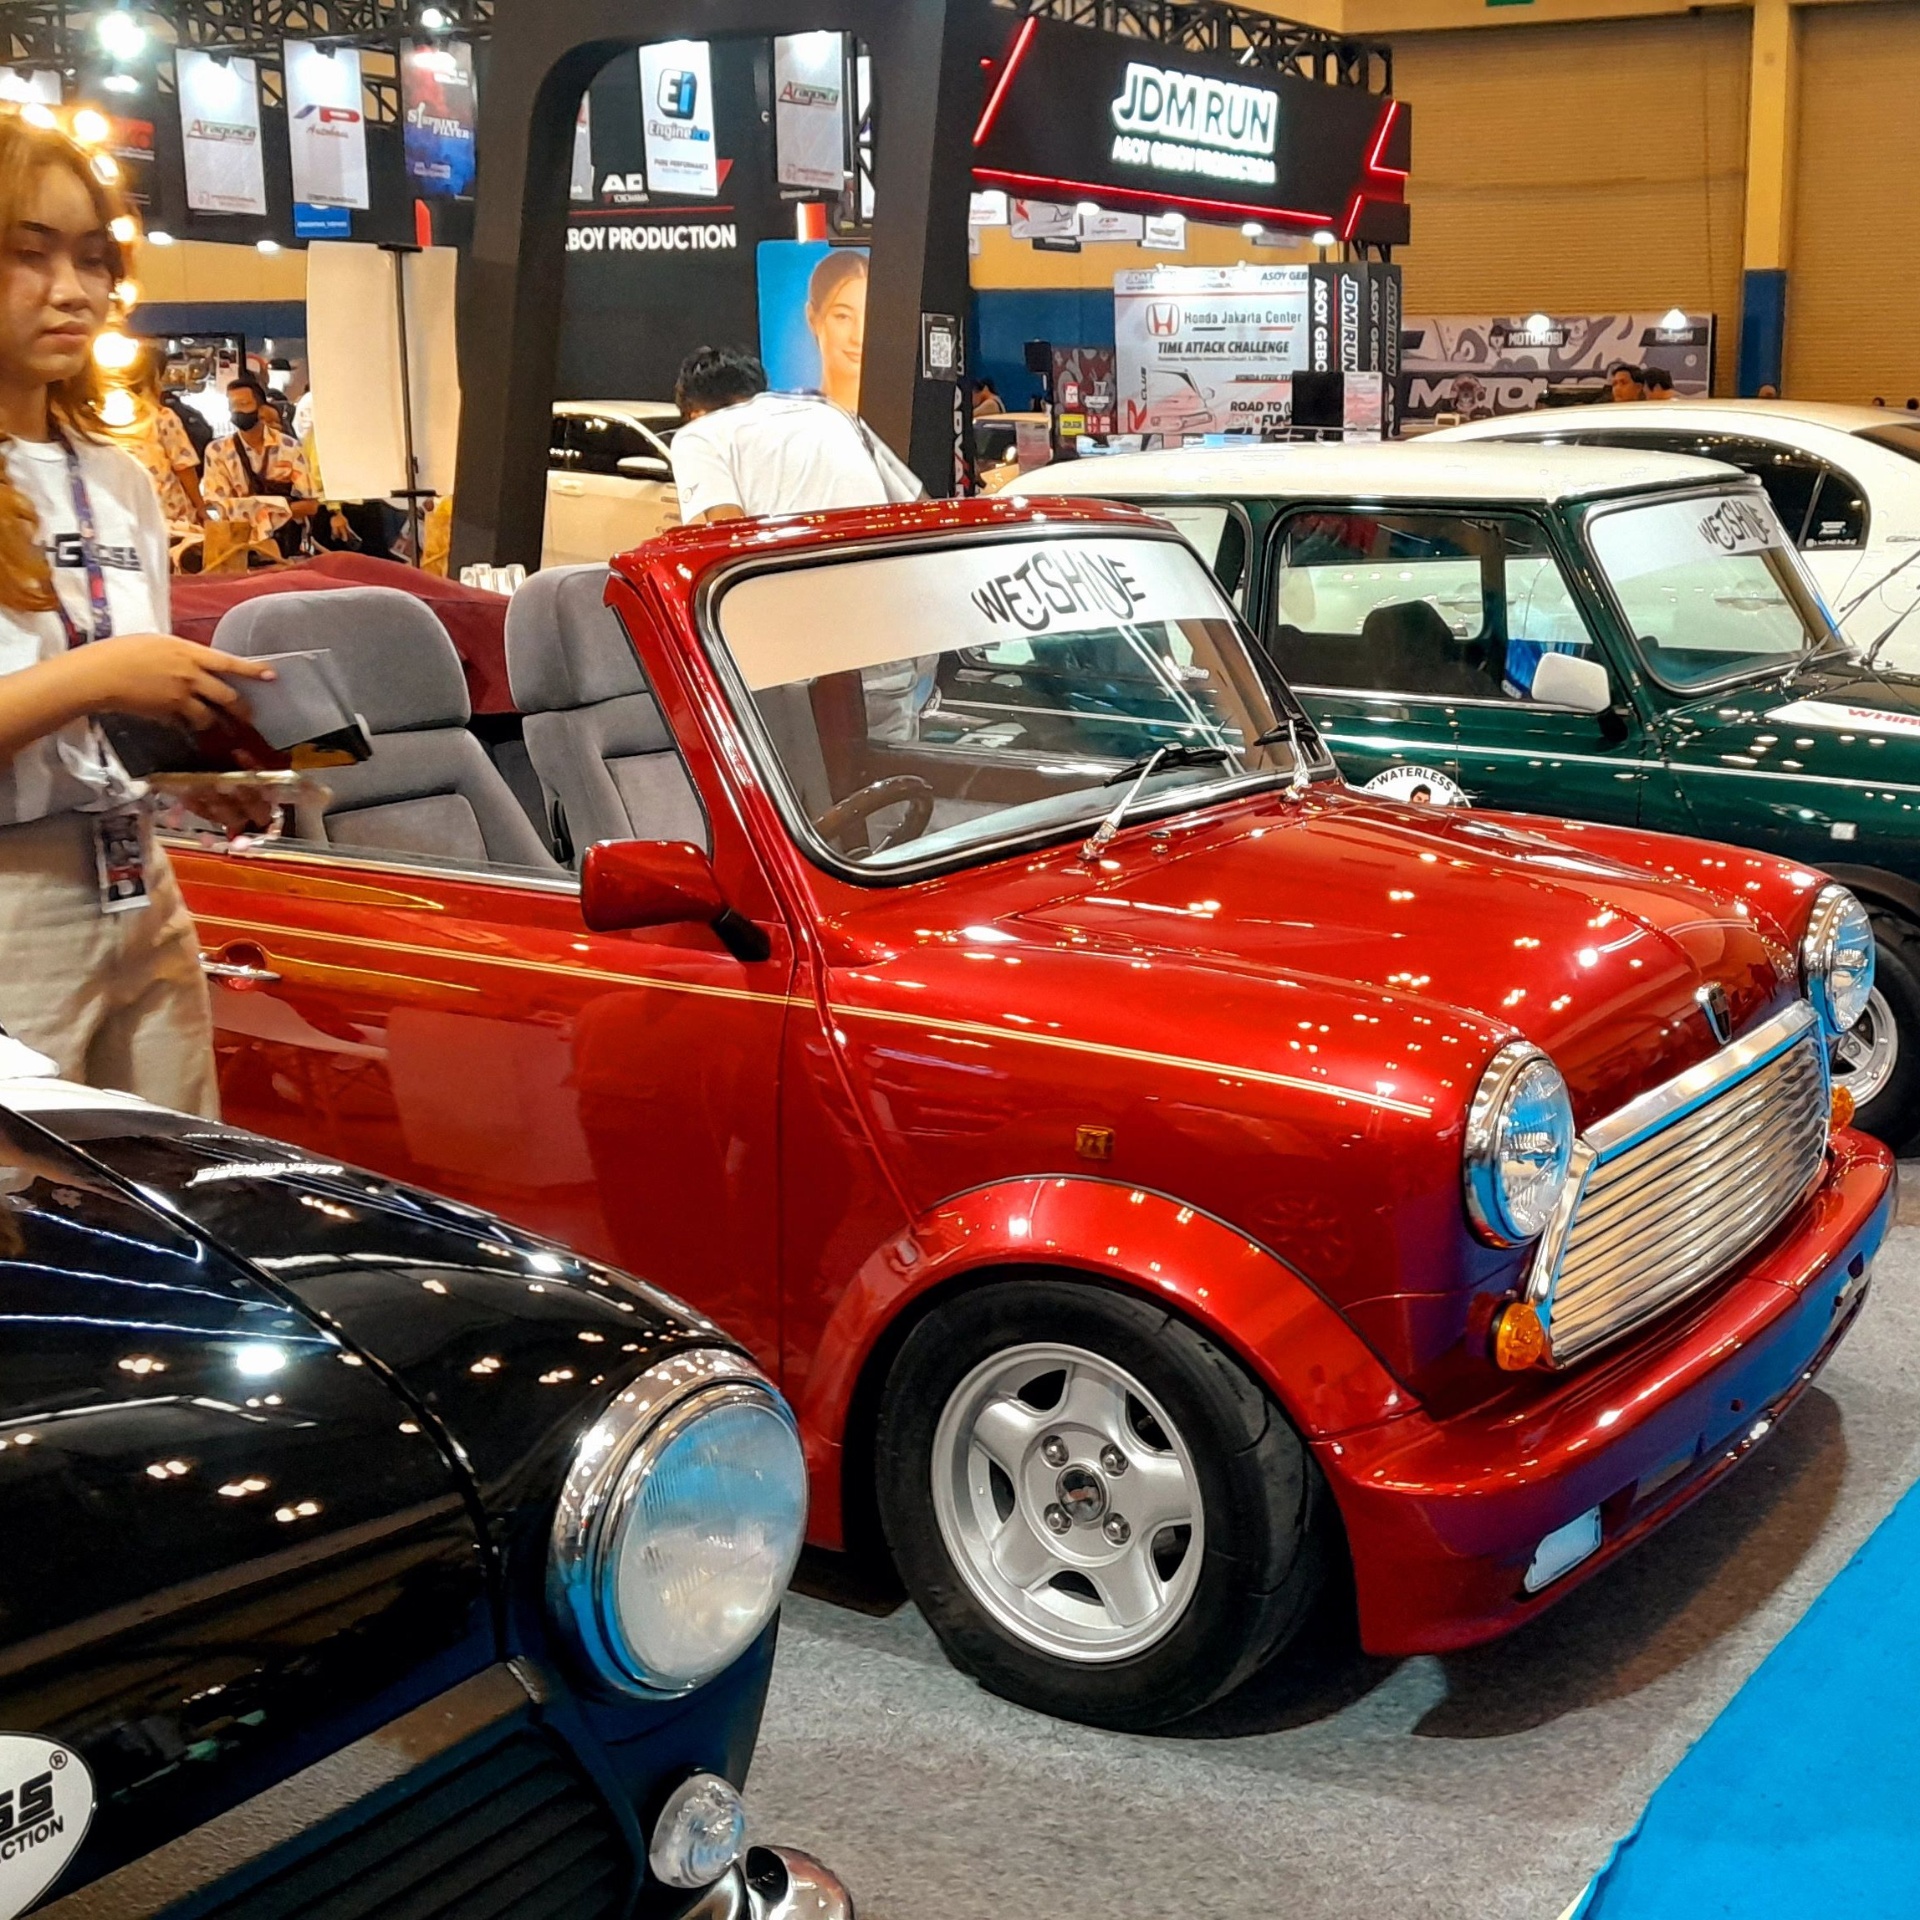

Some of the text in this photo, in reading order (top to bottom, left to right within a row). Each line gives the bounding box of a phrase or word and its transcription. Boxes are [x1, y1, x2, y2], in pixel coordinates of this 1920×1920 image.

[1117, 72, 1273, 145] JDM RUN
[565, 224, 737, 251] BOY PRODUCTION
[1261, 272, 1287, 281] ASOY
[1314, 278, 1328, 326] ASOY
[1341, 273, 1358, 328] JDM
[1184, 310, 1302, 326] Honda Jakarta Center
[1157, 340, 1290, 354] TIME ATTACK CHALLENGE
[1230, 401, 1283, 415] ROAD TO
[1376, 767, 1453, 792] WATERLESS
[0, 1814, 65, 1863] CTION
